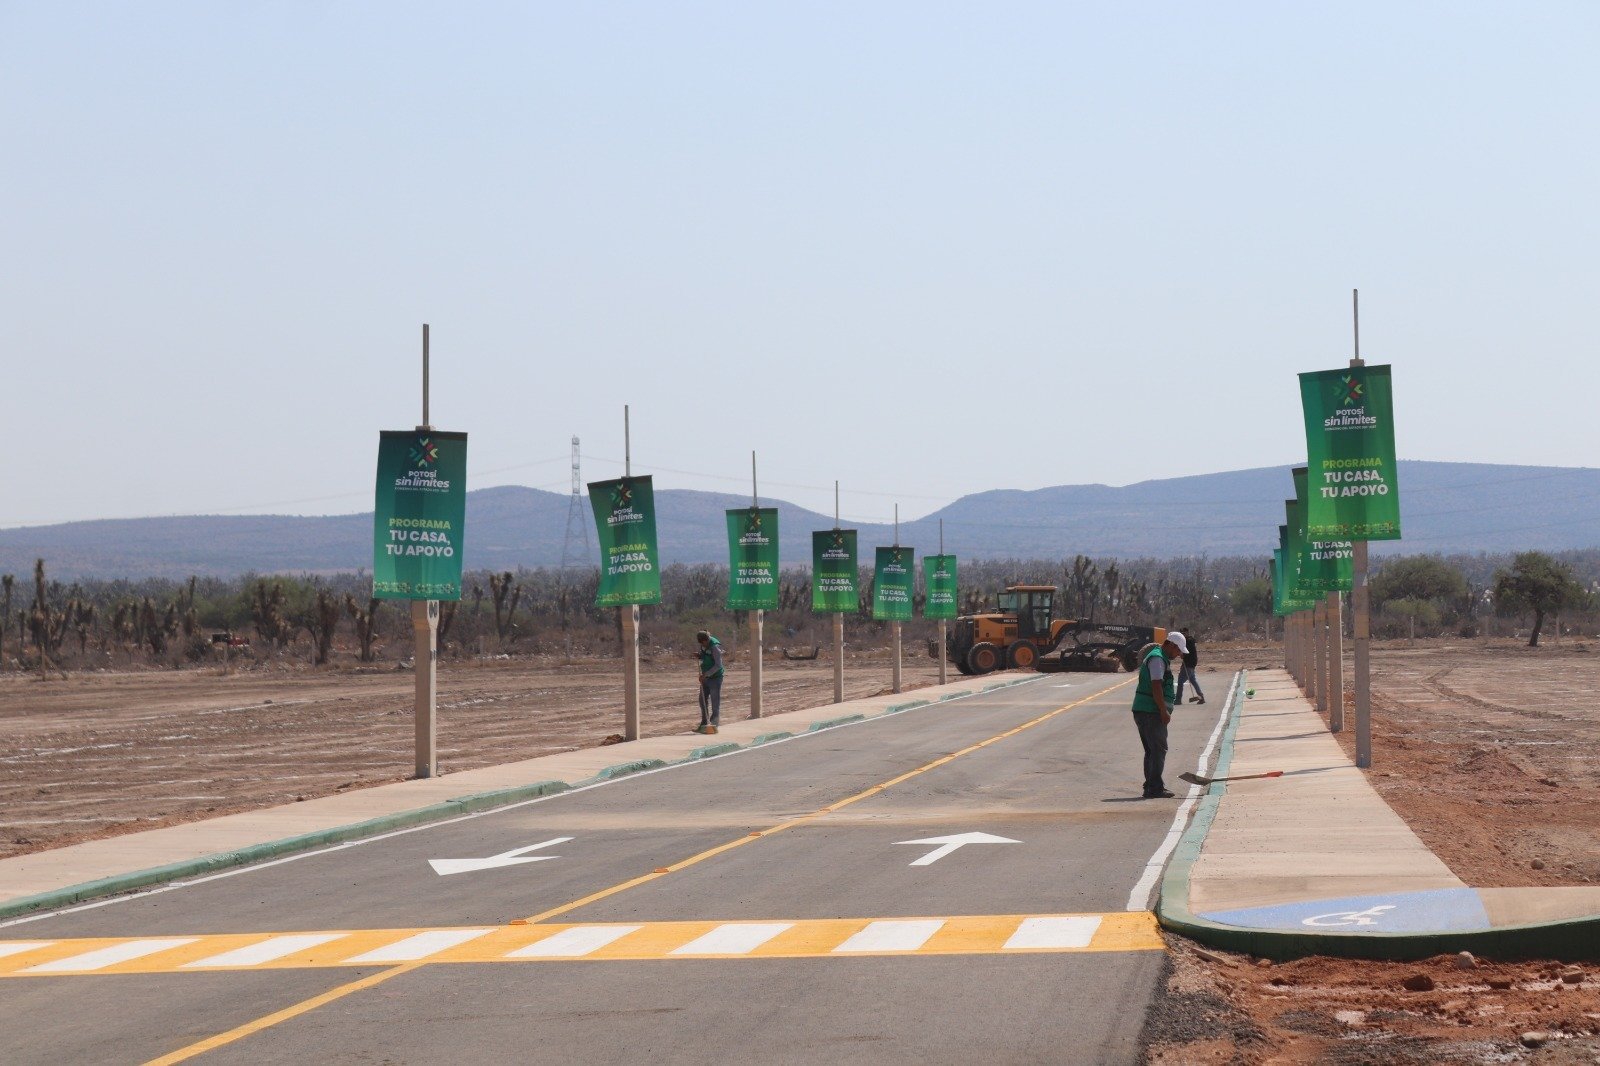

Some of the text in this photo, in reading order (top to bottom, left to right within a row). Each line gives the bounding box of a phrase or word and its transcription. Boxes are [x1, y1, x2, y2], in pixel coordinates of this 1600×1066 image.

[1325, 416, 1340, 427] sin
[1323, 457, 1383, 469] PROGRAMA
[395, 476, 411, 486] sin
[1324, 469, 1384, 483] TU CASA,
[1321, 484, 1388, 498] TU APOYO
[389, 518, 451, 529] PROGRAMA
[390, 530, 450, 545] TU CASA,
[609, 543, 648, 554] PROGRAMA
[1313, 541, 1324, 549] TU
[386, 545, 453, 557] TU APOYO
[1310, 552, 1322, 560] TU
[610, 552, 649, 564] TU CASA,
[608, 563, 652, 575] TU APOYO
[748, 568, 771, 577] CASA,
[745, 577, 773, 585] APOYO
